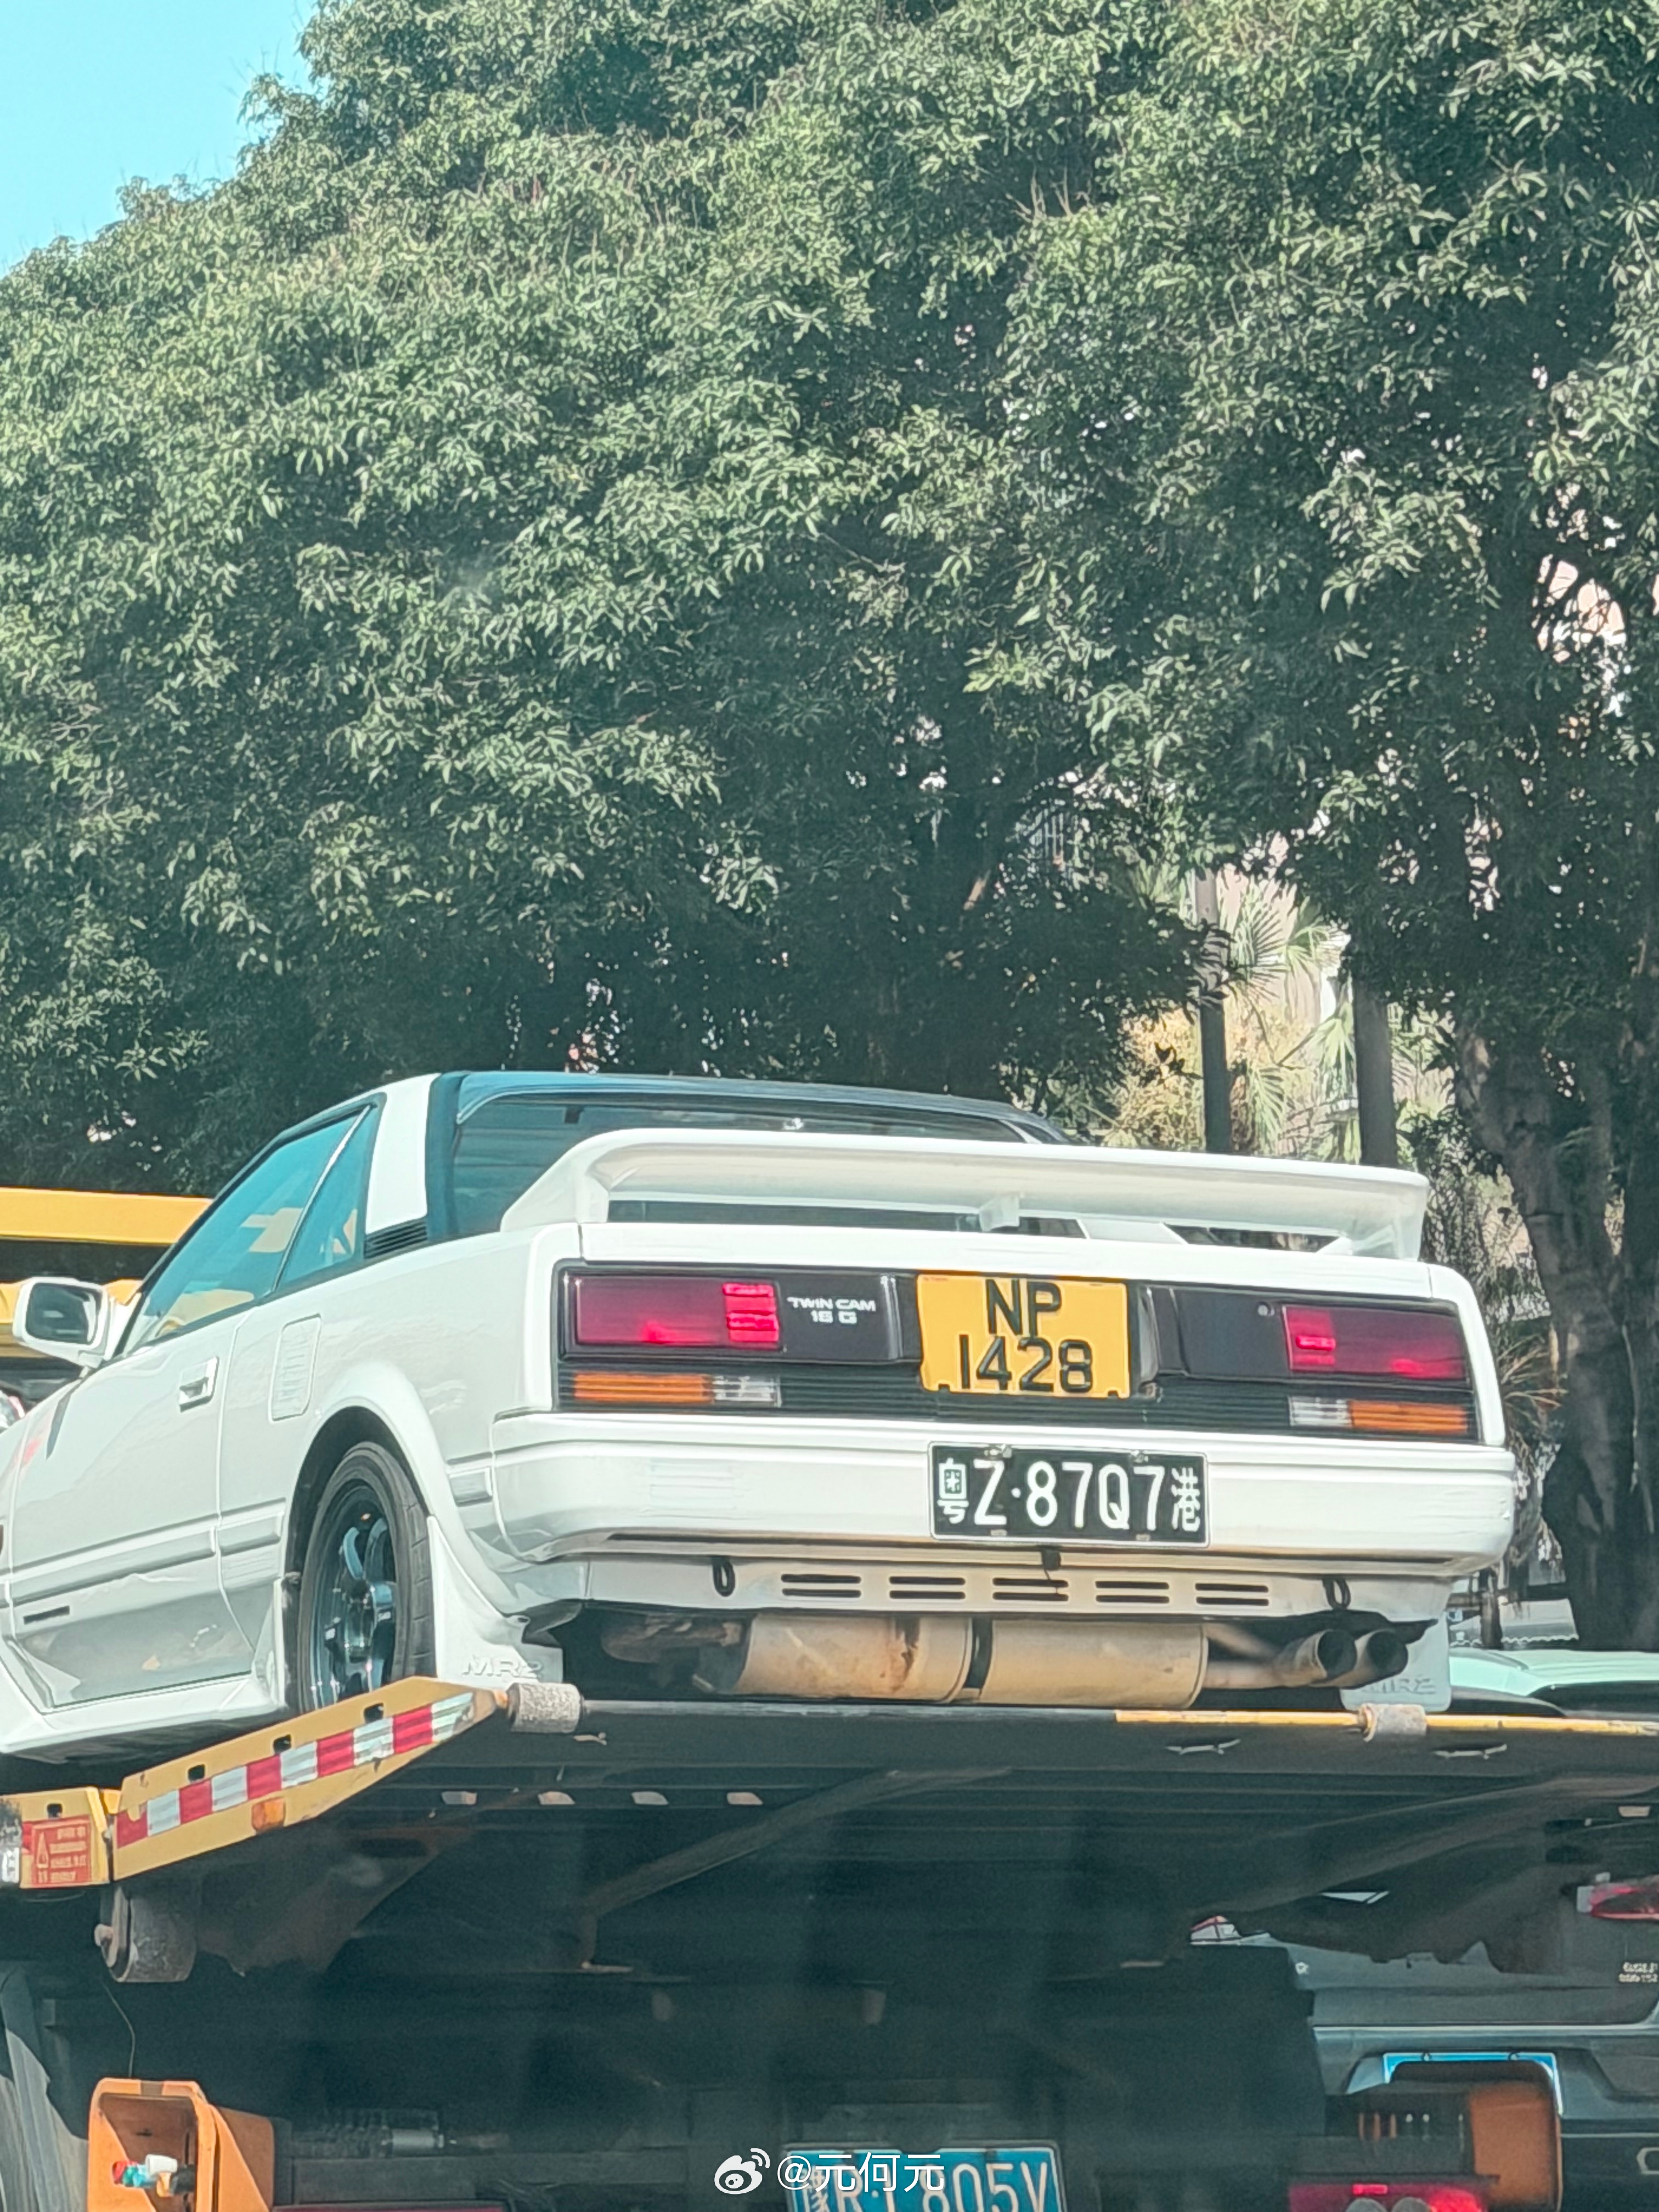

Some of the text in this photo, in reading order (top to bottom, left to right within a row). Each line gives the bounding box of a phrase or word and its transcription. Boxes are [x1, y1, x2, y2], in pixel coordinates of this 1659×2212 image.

[787, 1296, 876, 1311] TWIN CAM
[985, 1279, 1061, 1336] NP
[959, 1334, 1093, 1393] 1428
